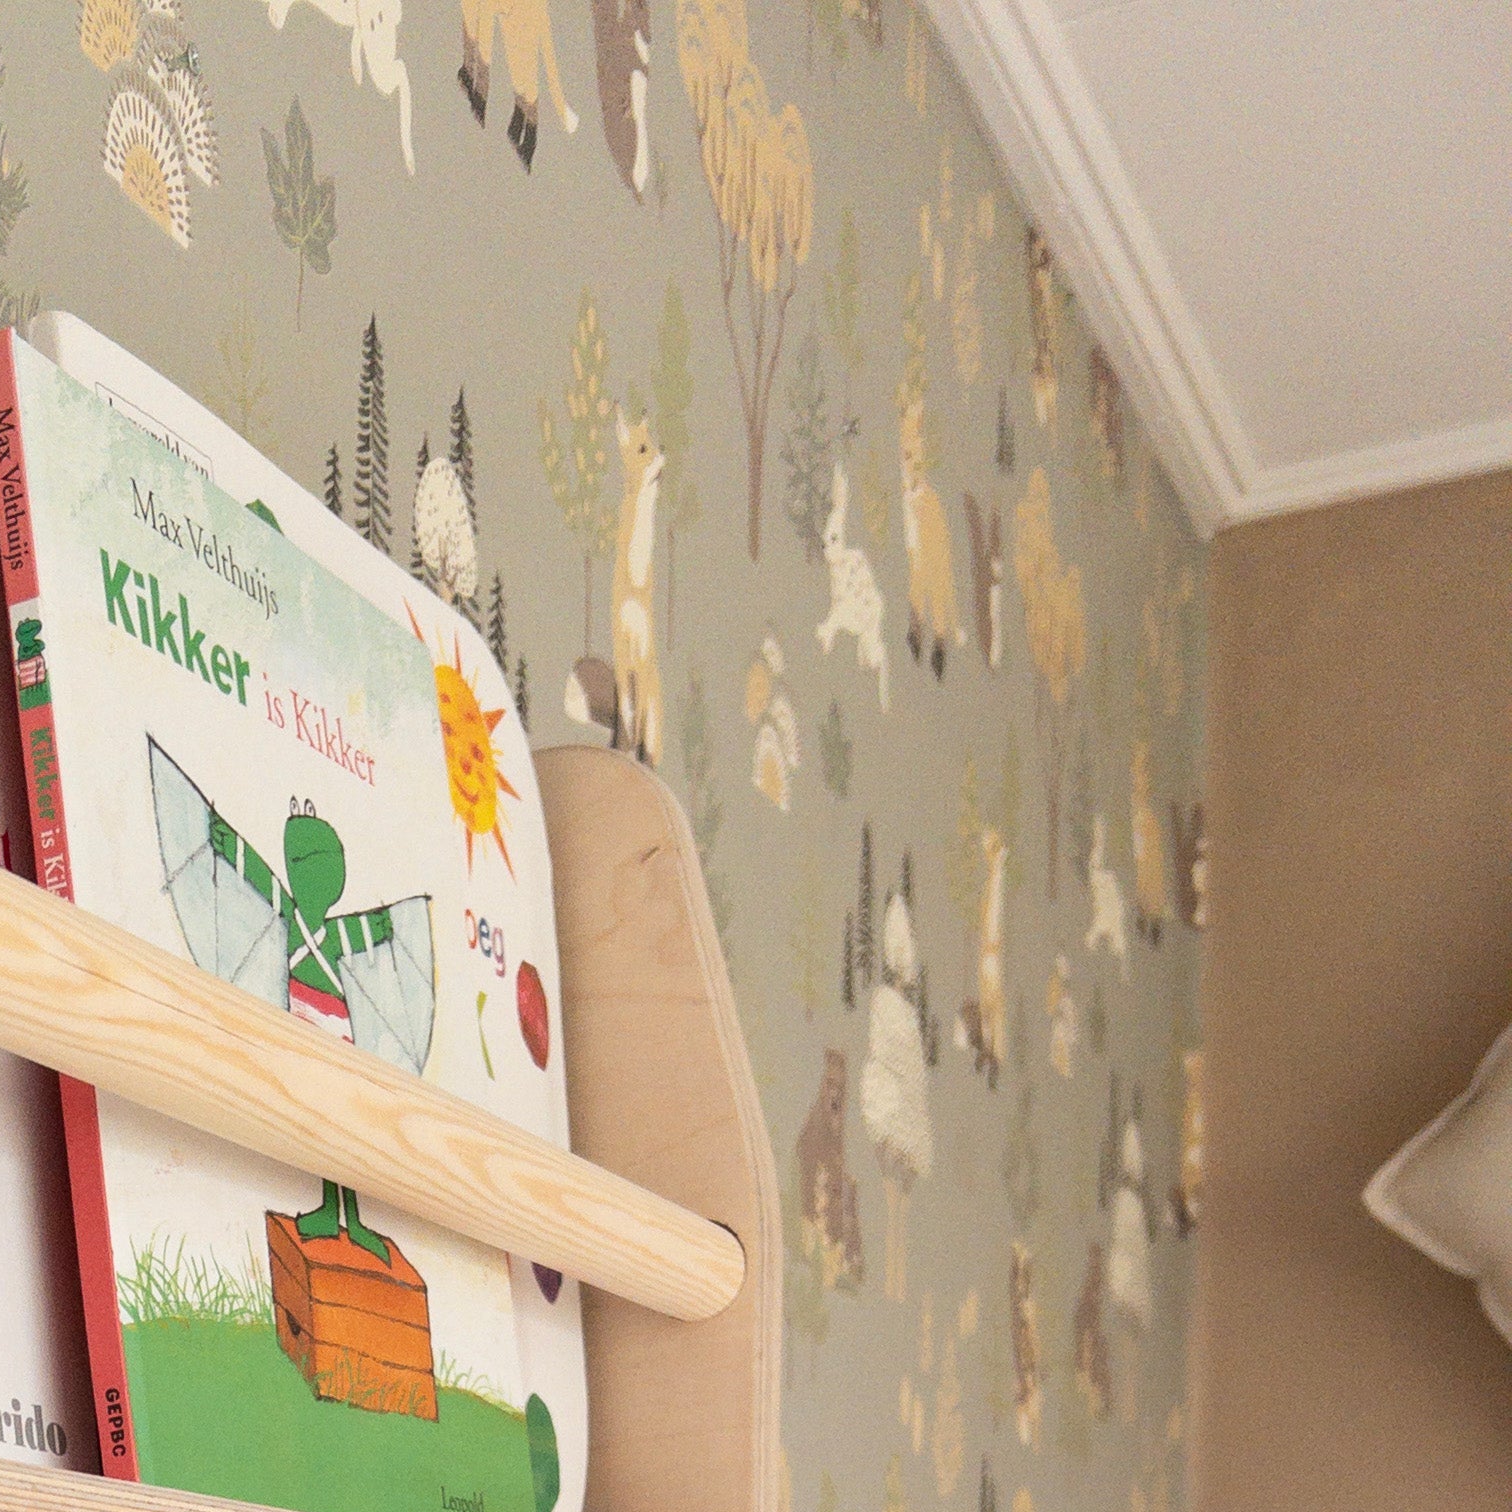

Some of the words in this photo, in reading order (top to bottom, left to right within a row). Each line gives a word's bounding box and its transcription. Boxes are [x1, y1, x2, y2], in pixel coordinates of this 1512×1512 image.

[1, 464, 29, 570] Velthuijs
[129, 477, 185, 550] Max
[184, 515, 280, 620] Velthuijs
[99, 547, 250, 707] Kikker
[262, 671, 286, 729] is
[289, 688, 376, 787] Kikker
[30, 727, 59, 821] Kikker
[40, 827, 61, 849] is
[105, 1387, 126, 1457] GEPBC
